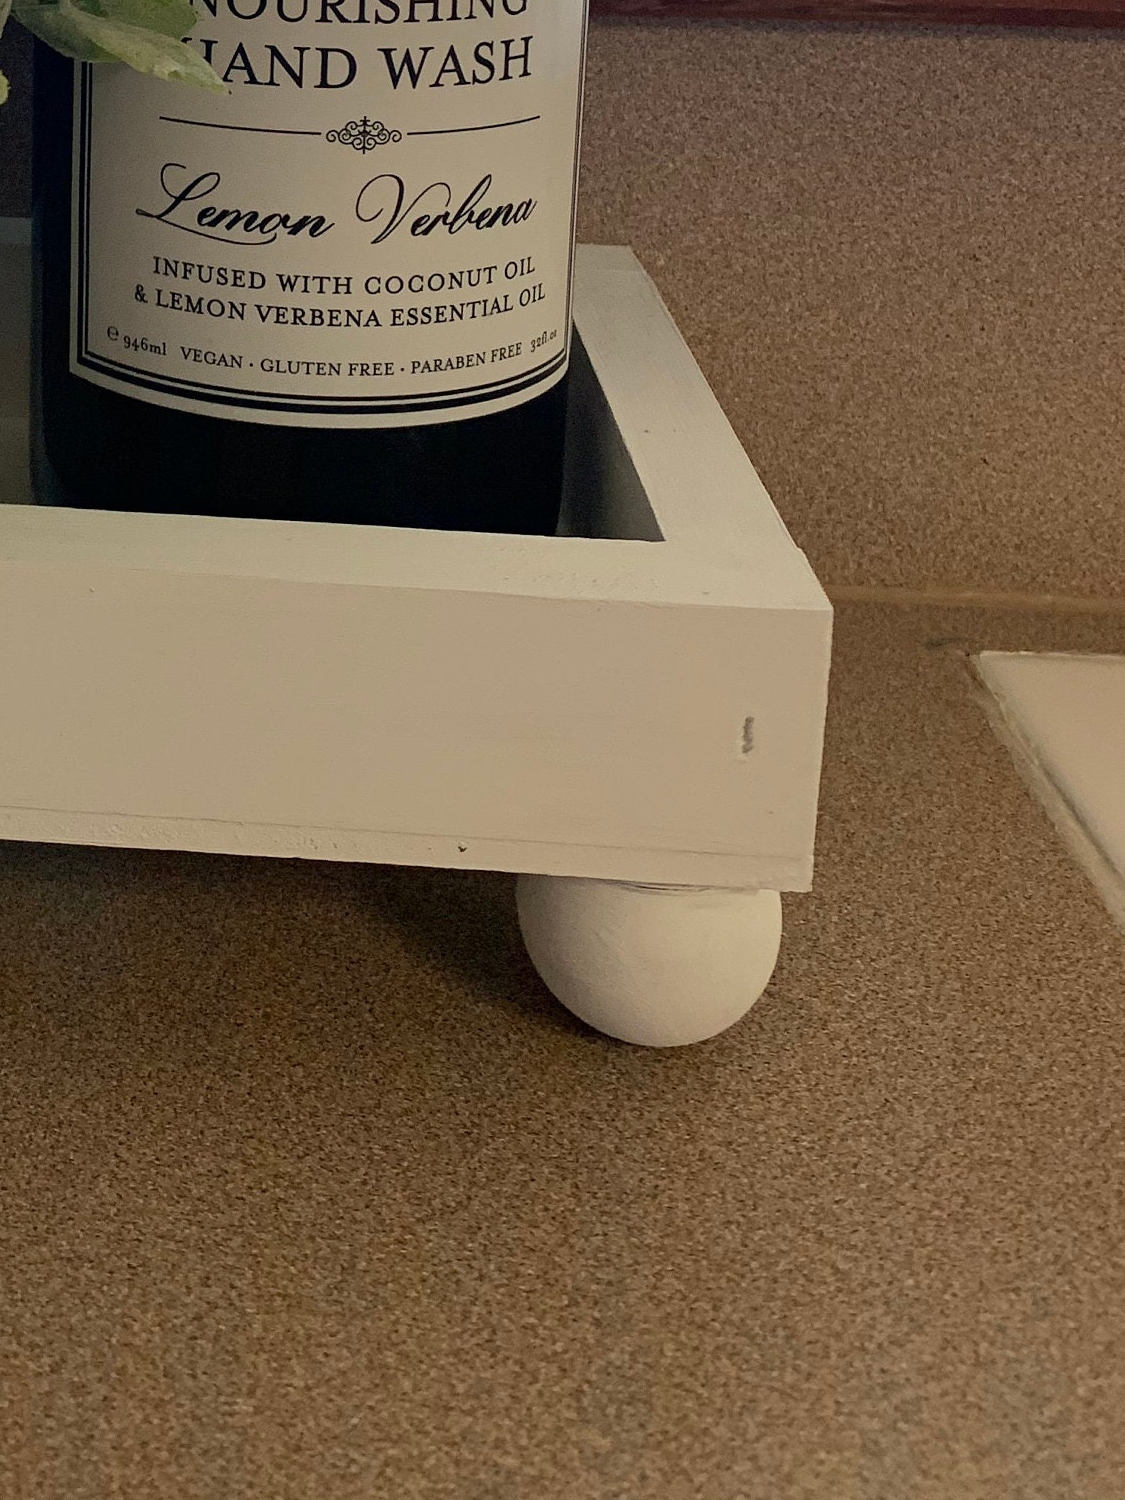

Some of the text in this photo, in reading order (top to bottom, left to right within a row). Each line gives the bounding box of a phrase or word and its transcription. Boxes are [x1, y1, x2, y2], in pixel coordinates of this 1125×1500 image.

[377, 35, 534, 90] WASH
[135, 162, 538, 246] Lemon Verbena
[153, 256, 536, 295] INFUSED WITH COCONUT OIL
[134, 283, 546, 328] & LEMON VERBENA ESSENTIAL OIL
[123, 335, 167, 356] 946ml
[180, 346, 243, 369] VEGAN
[260, 358, 341, 376] GLUTEN
[348, 363, 395, 376] FREE
[410, 352, 487, 375] PARABEN
[491, 342, 523, 363] FREE
